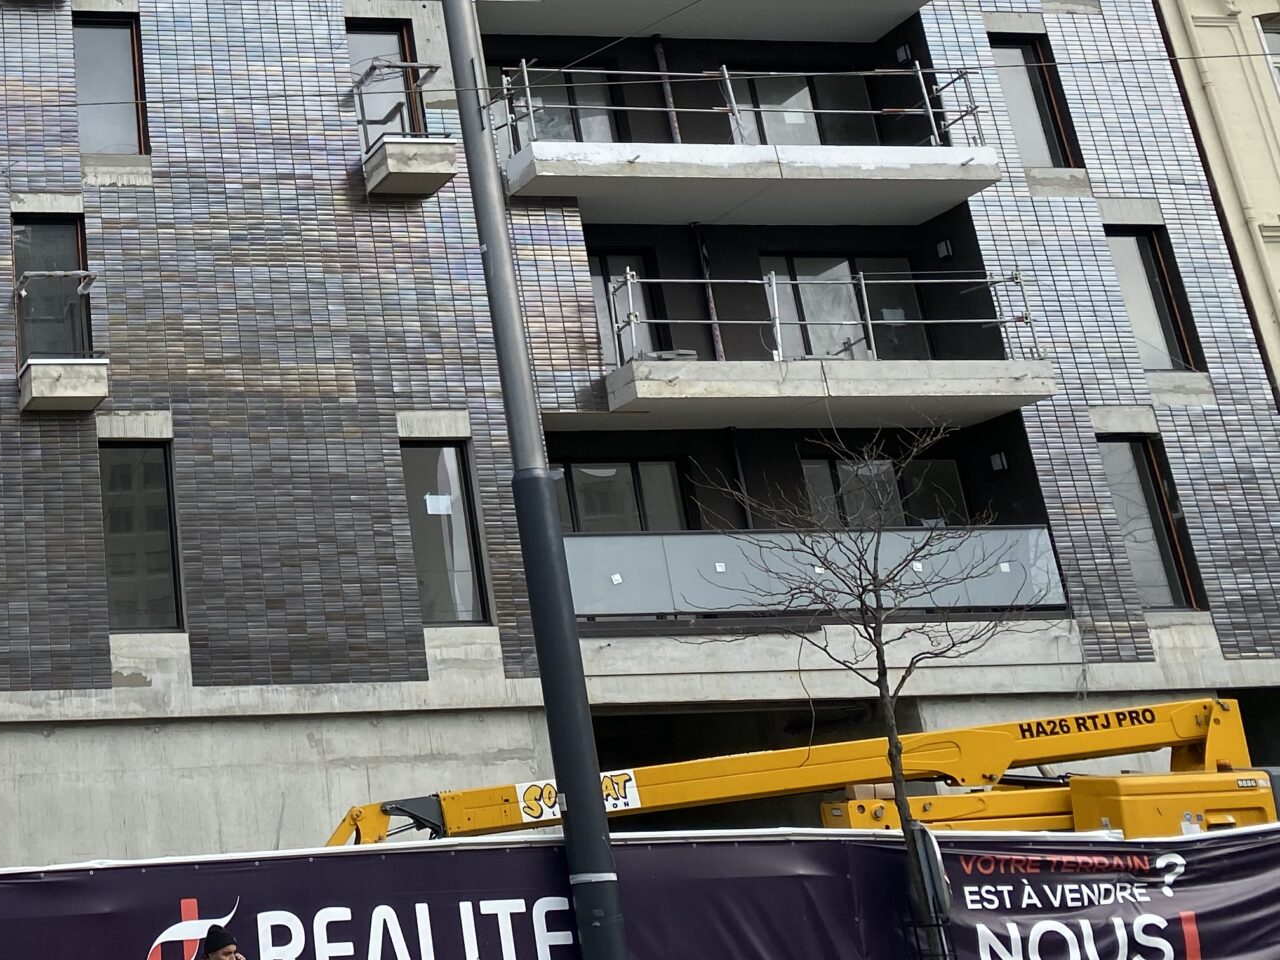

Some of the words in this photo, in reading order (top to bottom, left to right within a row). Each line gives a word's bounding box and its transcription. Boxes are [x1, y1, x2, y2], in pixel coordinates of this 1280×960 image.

[1018, 718, 1070, 740] HA26
[1074, 713, 1111, 733] RTJ
[1115, 708, 1156, 728] PRO
[959, 855, 1041, 875] VOTRE
[1049, 854, 1150, 874] TERRAIN
[963, 885, 1014, 910] EST
[1020, 878, 1043, 909] À
[1043, 882, 1152, 909] VENDRE
